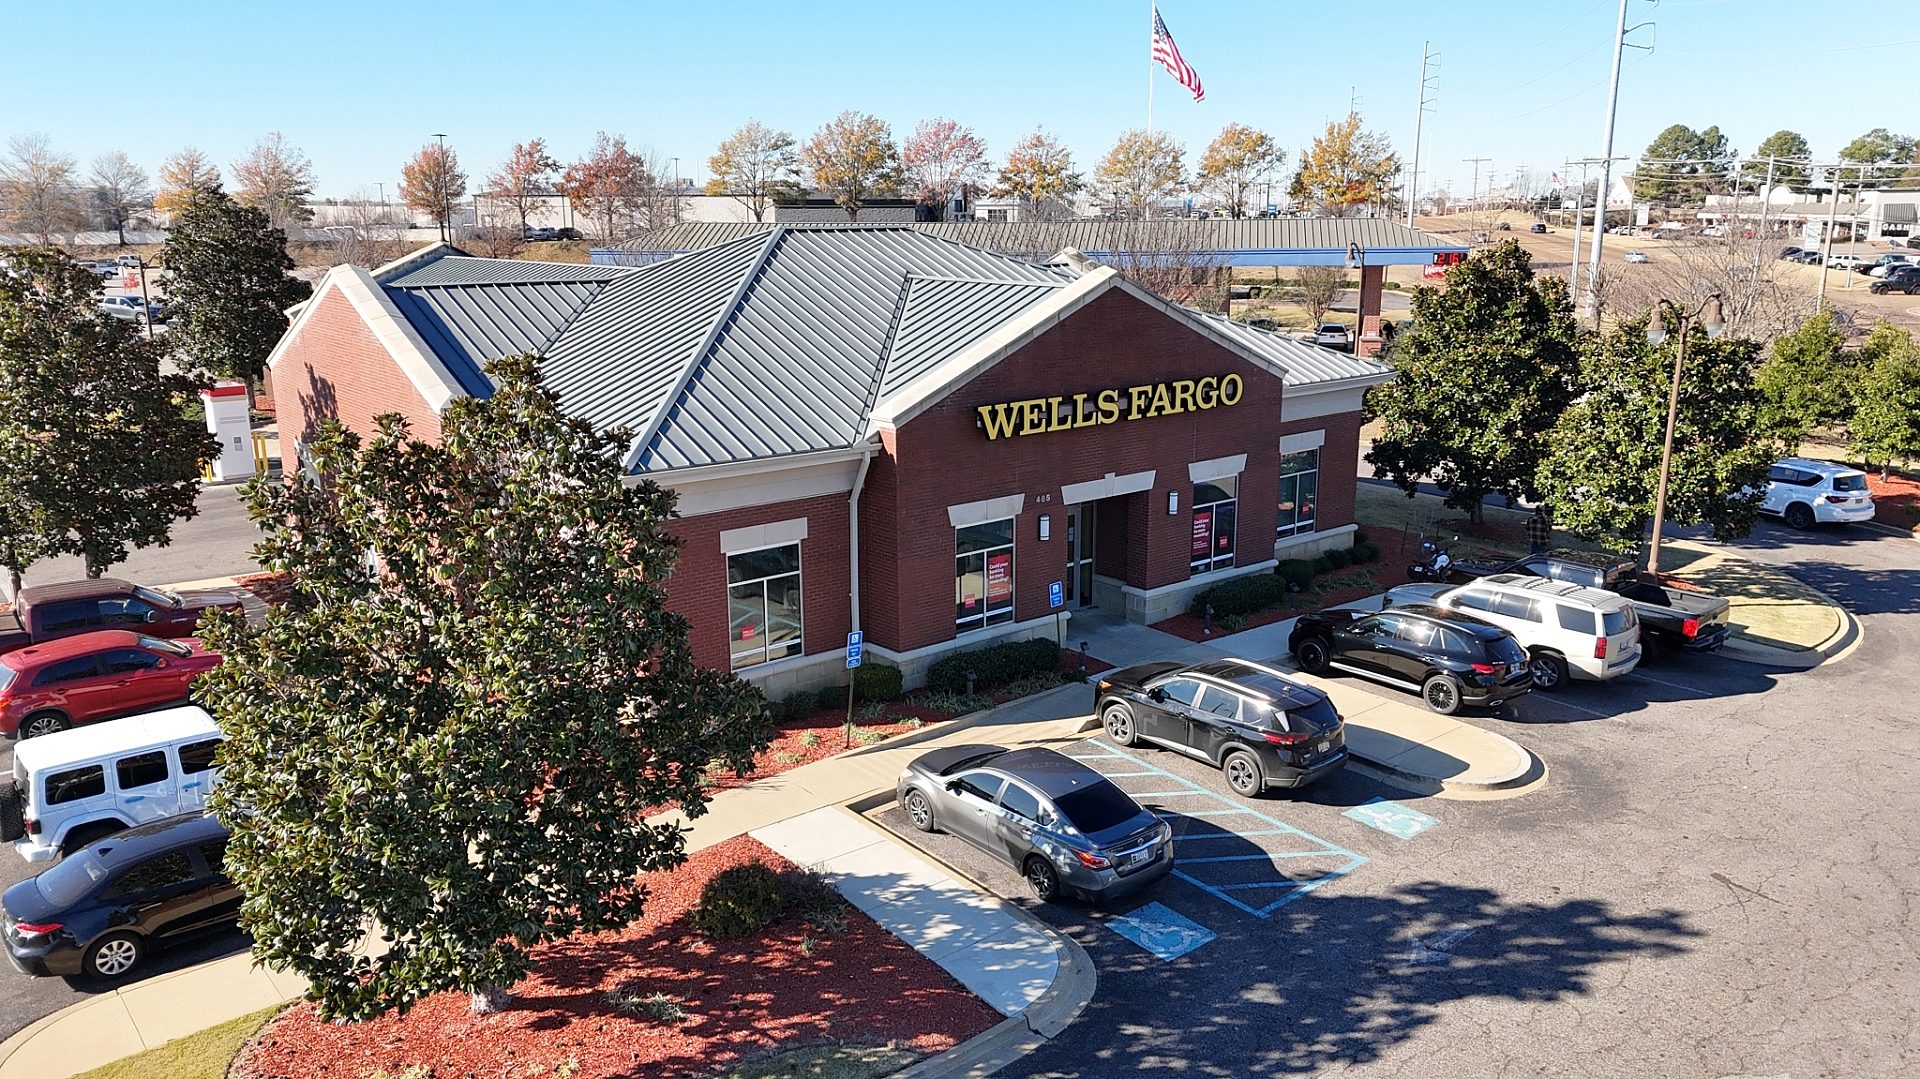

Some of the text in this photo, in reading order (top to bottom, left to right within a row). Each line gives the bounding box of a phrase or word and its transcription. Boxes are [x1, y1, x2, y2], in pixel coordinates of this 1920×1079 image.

[1882, 223, 1910, 231] CASH
[977, 373, 1244, 441] WELLS FARGO
